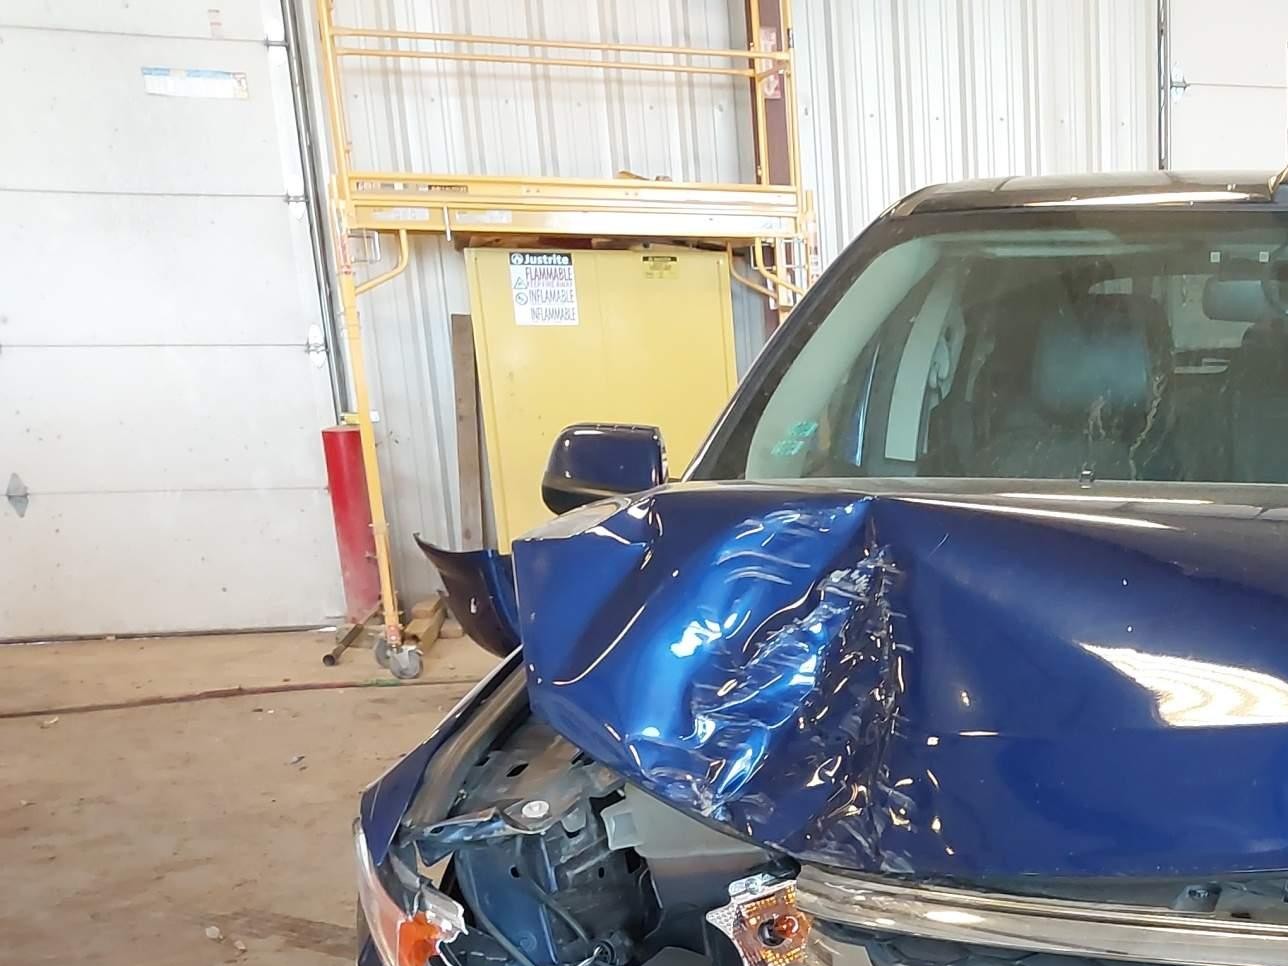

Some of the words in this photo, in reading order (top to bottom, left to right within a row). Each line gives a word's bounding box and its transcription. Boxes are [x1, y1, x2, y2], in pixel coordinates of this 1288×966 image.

[524, 253, 569, 265] Justrite
[525, 267, 573, 281] FLAMMABLE
[528, 289, 575, 303] INFLAMABLE
[530, 307, 576, 321] INFLAMMABLE
